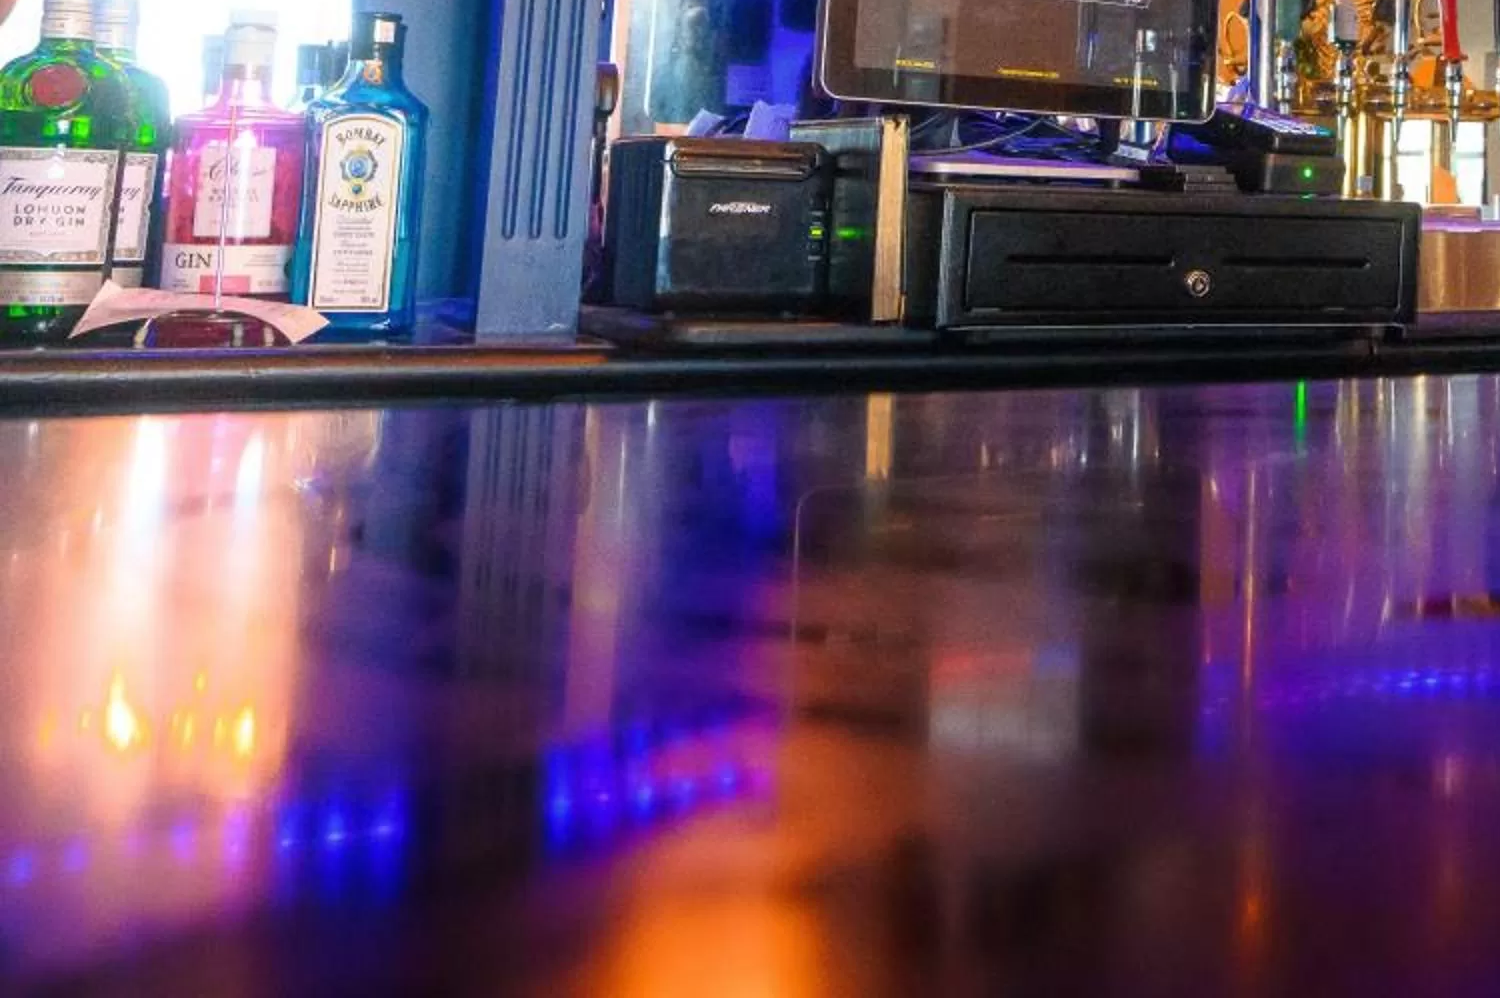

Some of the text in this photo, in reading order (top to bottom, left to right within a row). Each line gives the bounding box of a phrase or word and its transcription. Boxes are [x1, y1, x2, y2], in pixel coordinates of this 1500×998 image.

[335, 127, 385, 146] BOMBAY
[2, 176, 103, 201] Tanqueray
[14, 204, 87, 215] LONDON
[175, 251, 212, 269] GIN
